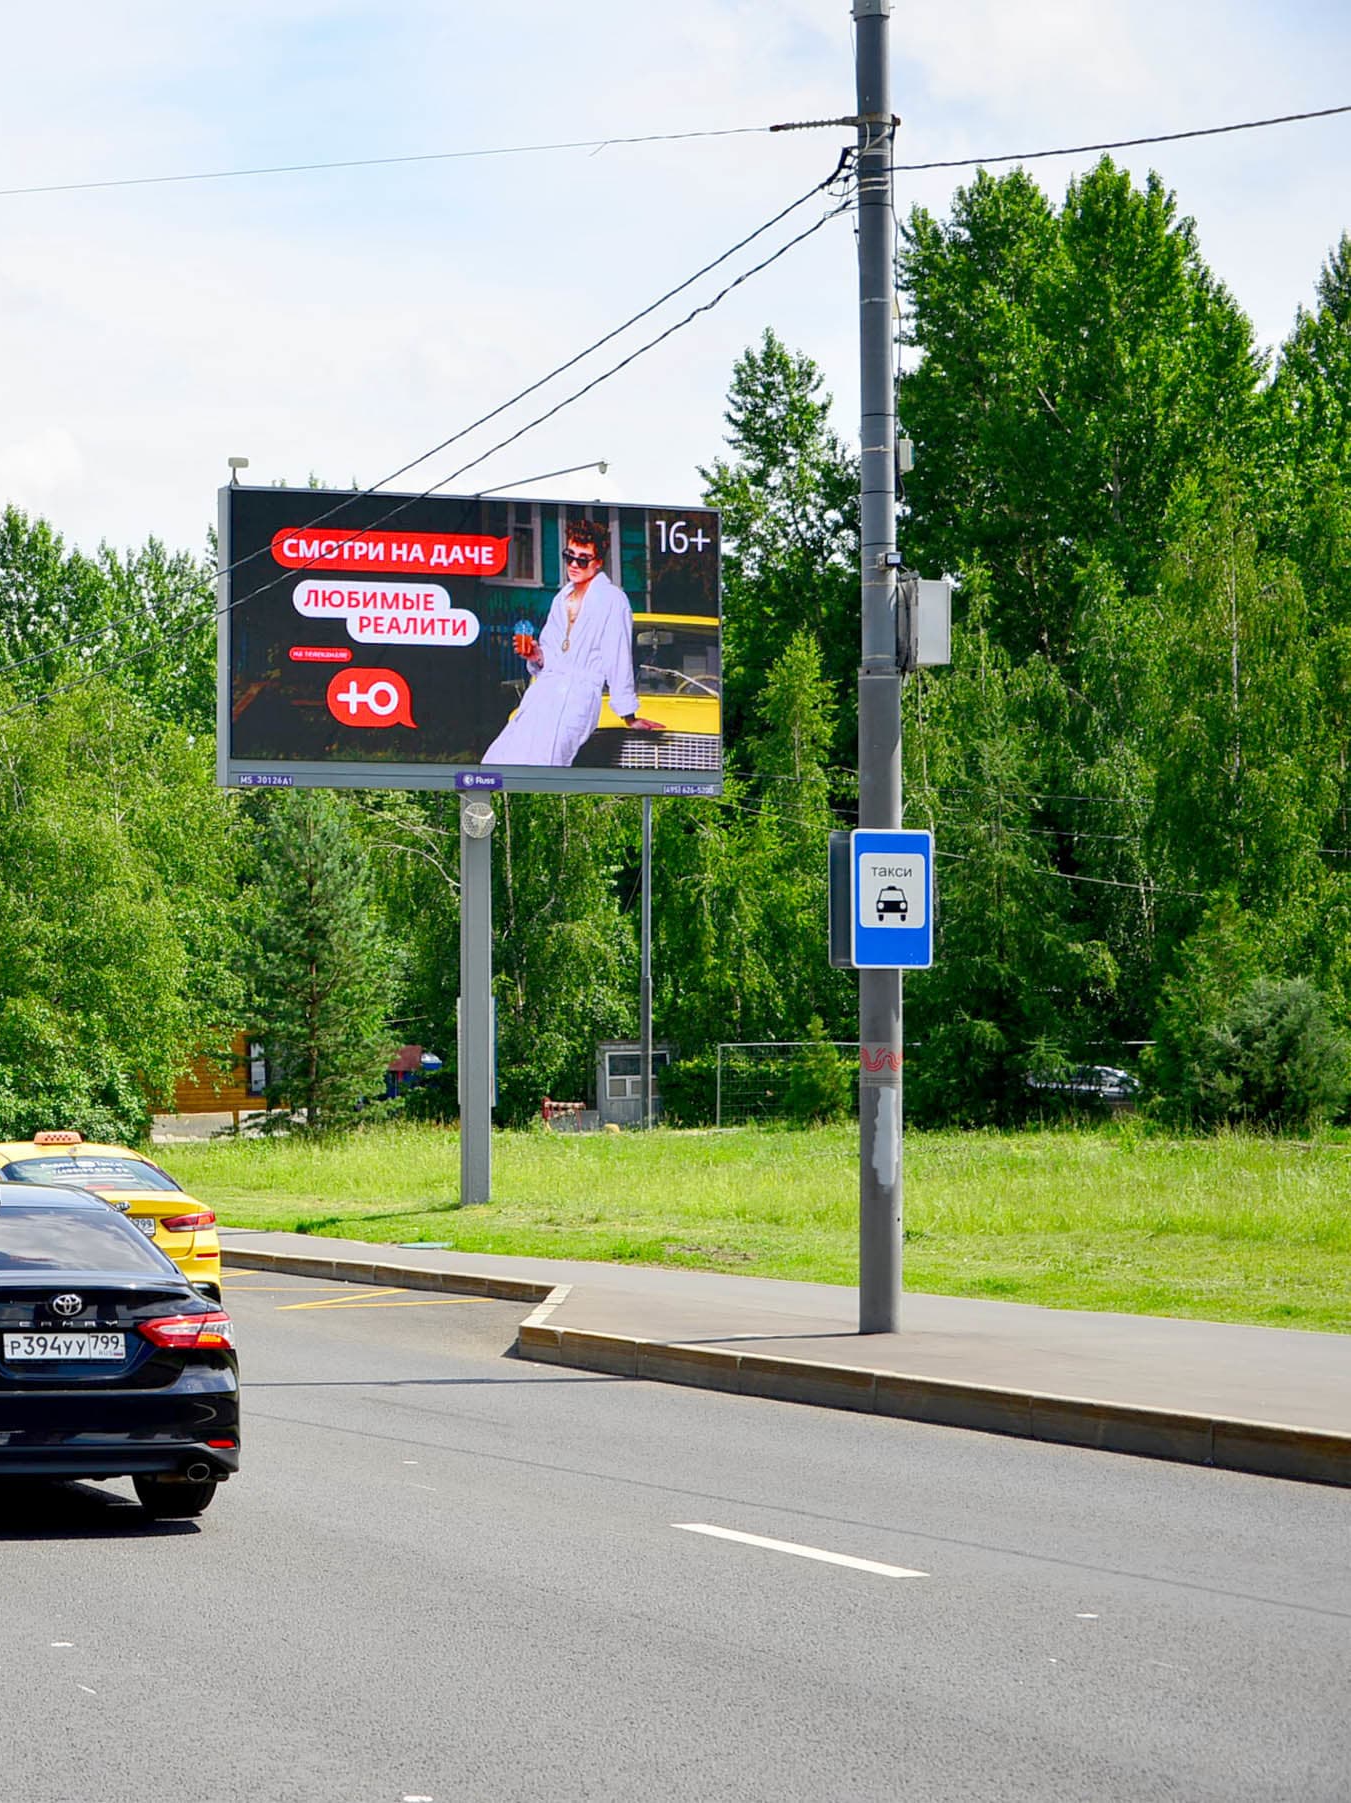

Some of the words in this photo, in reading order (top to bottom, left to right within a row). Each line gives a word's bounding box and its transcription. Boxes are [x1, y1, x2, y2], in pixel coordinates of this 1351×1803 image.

[655, 521, 711, 554] 16+
[282, 538, 385, 561] СМОТРИ
[391, 543, 425, 563] НА
[429, 544, 494, 567] ДАЧЕ
[303, 589, 435, 611] ЛЮБИМЫЕ
[358, 616, 467, 637] РЕАЛИТИ
[337, 681, 399, 715] Ю
[871, 866, 913, 878] такси
[90, 1335, 120, 1350] 799
